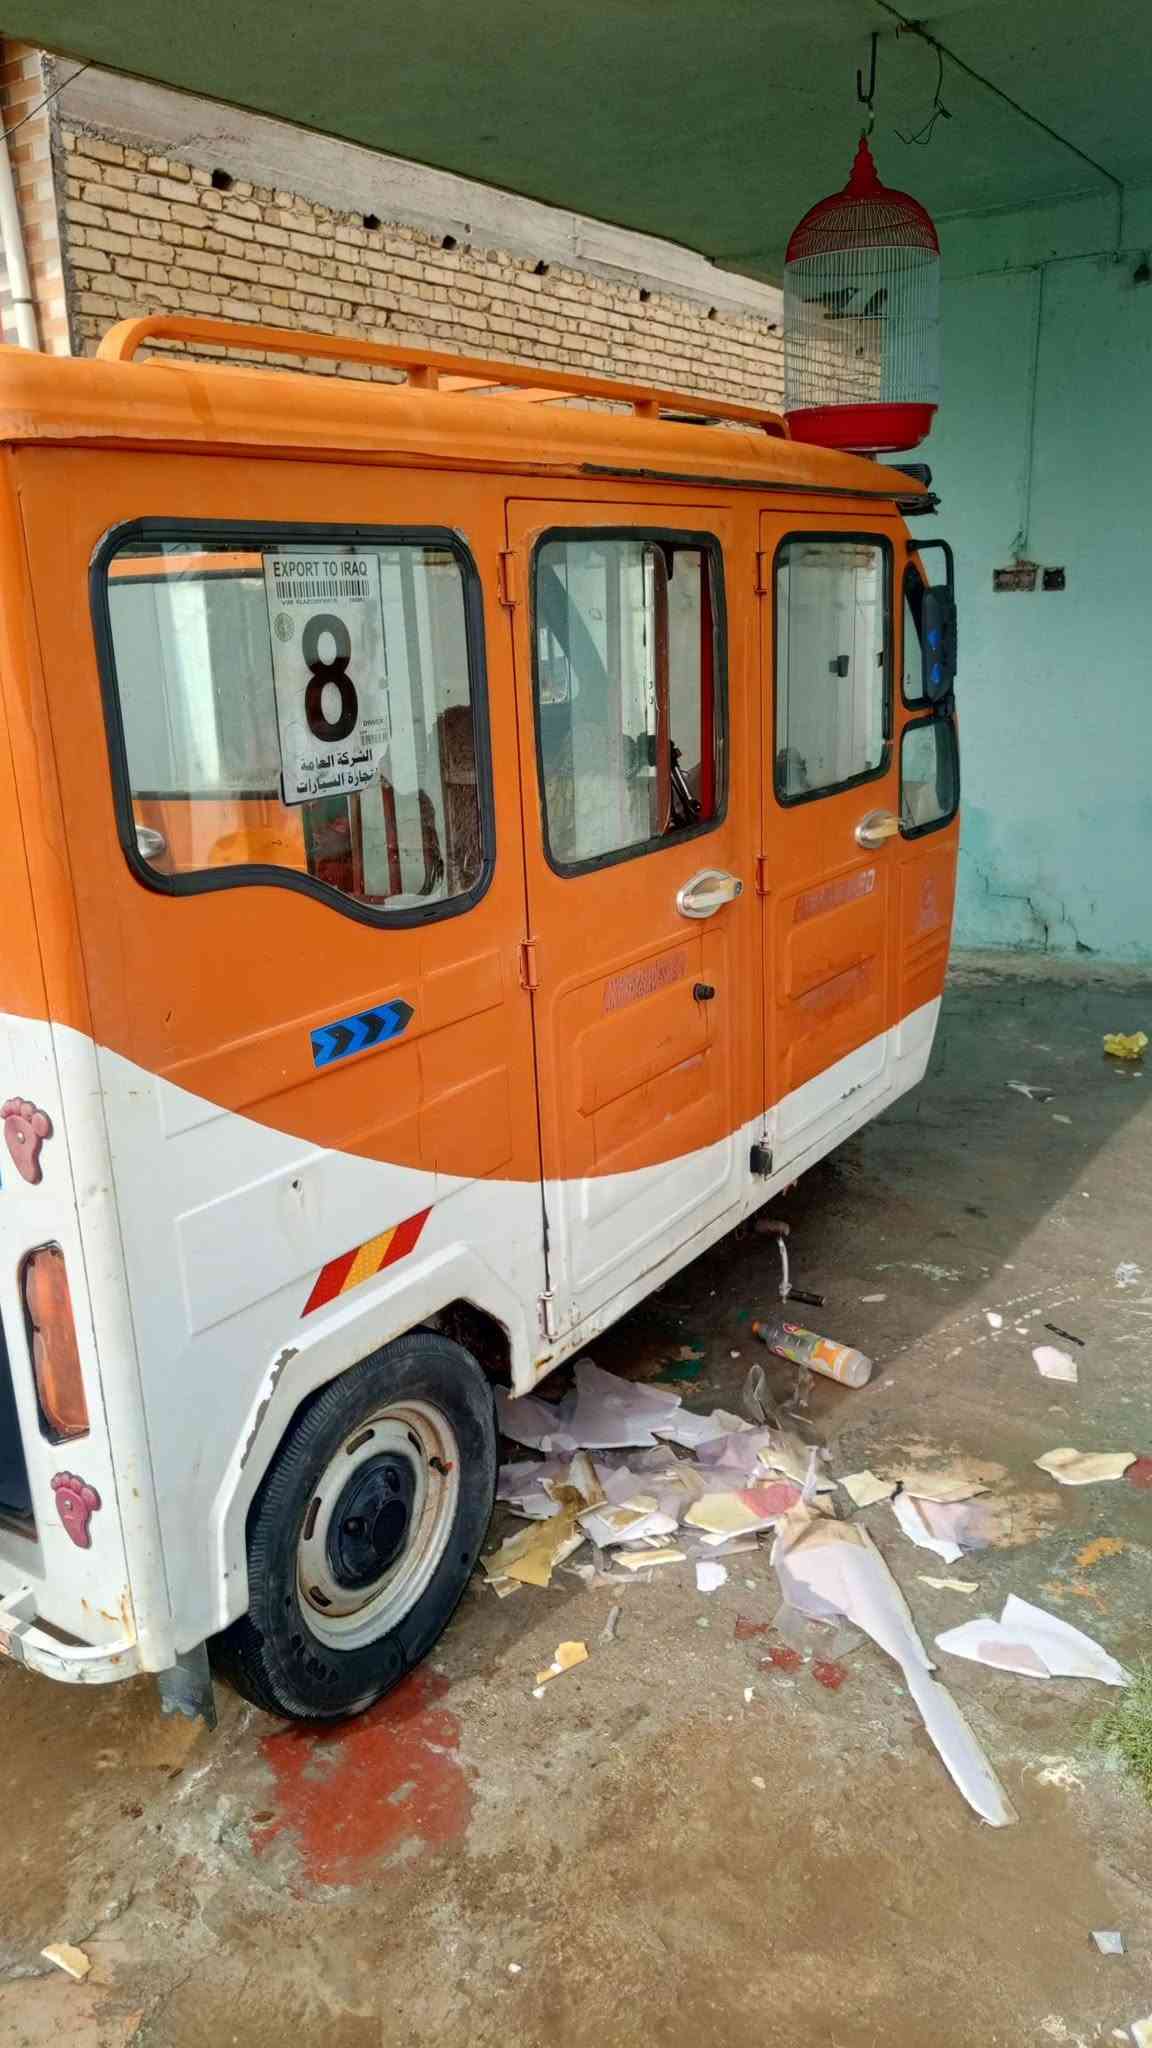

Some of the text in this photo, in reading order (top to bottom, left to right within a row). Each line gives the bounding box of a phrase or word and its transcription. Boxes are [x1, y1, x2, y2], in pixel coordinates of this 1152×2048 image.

[273, 560, 368, 577] EXPORT TO IRAQ
[302, 613, 359, 743] 8
[300, 747, 373, 771] الشركة العامة
[296, 767, 376, 794] تجارة السيارات
